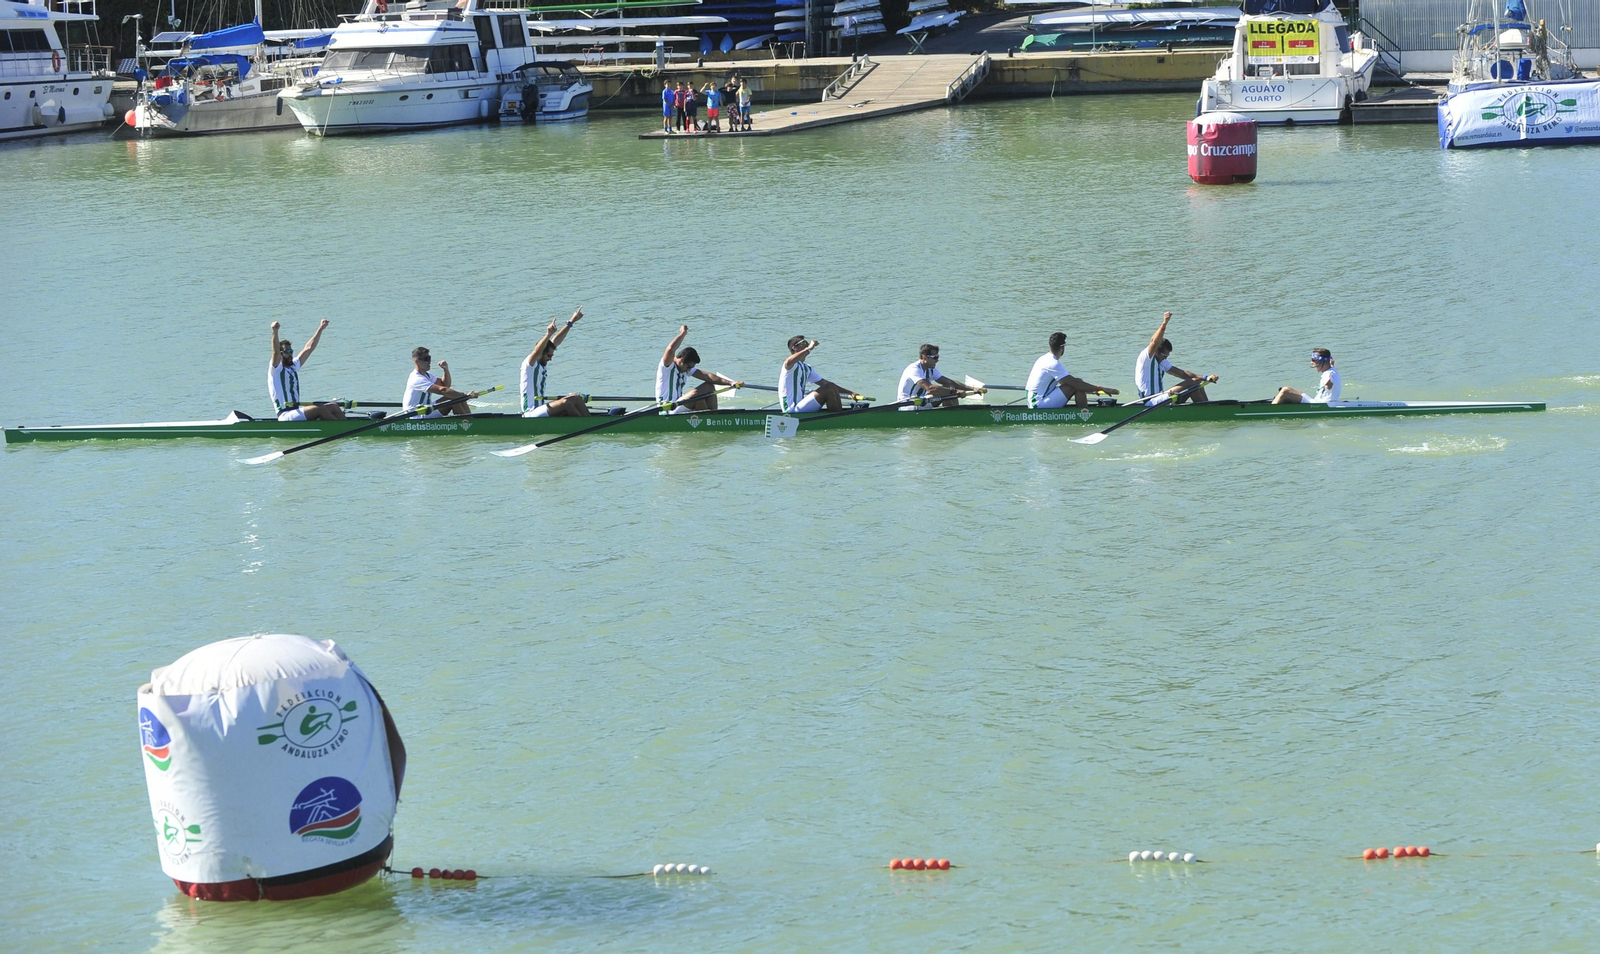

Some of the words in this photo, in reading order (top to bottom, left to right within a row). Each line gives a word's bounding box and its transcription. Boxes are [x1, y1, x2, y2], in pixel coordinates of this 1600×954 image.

[1250, 22, 1316, 34] LLEGADA
[1241, 85, 1285, 93] AGUAYO
[1497, 86, 1559, 102] FEDERACION
[1244, 95, 1282, 103] CUARTO
[1543, 117, 1563, 132] REMO
[1200, 143, 1256, 157] Cruzcampo
[706, 418, 733, 426] Benito
[734, 418, 766, 426] Villama
[281, 743, 329, 759] ANDALUZA
[330, 728, 349, 751] REMO
[325, 838, 345, 847] SEVILLA
